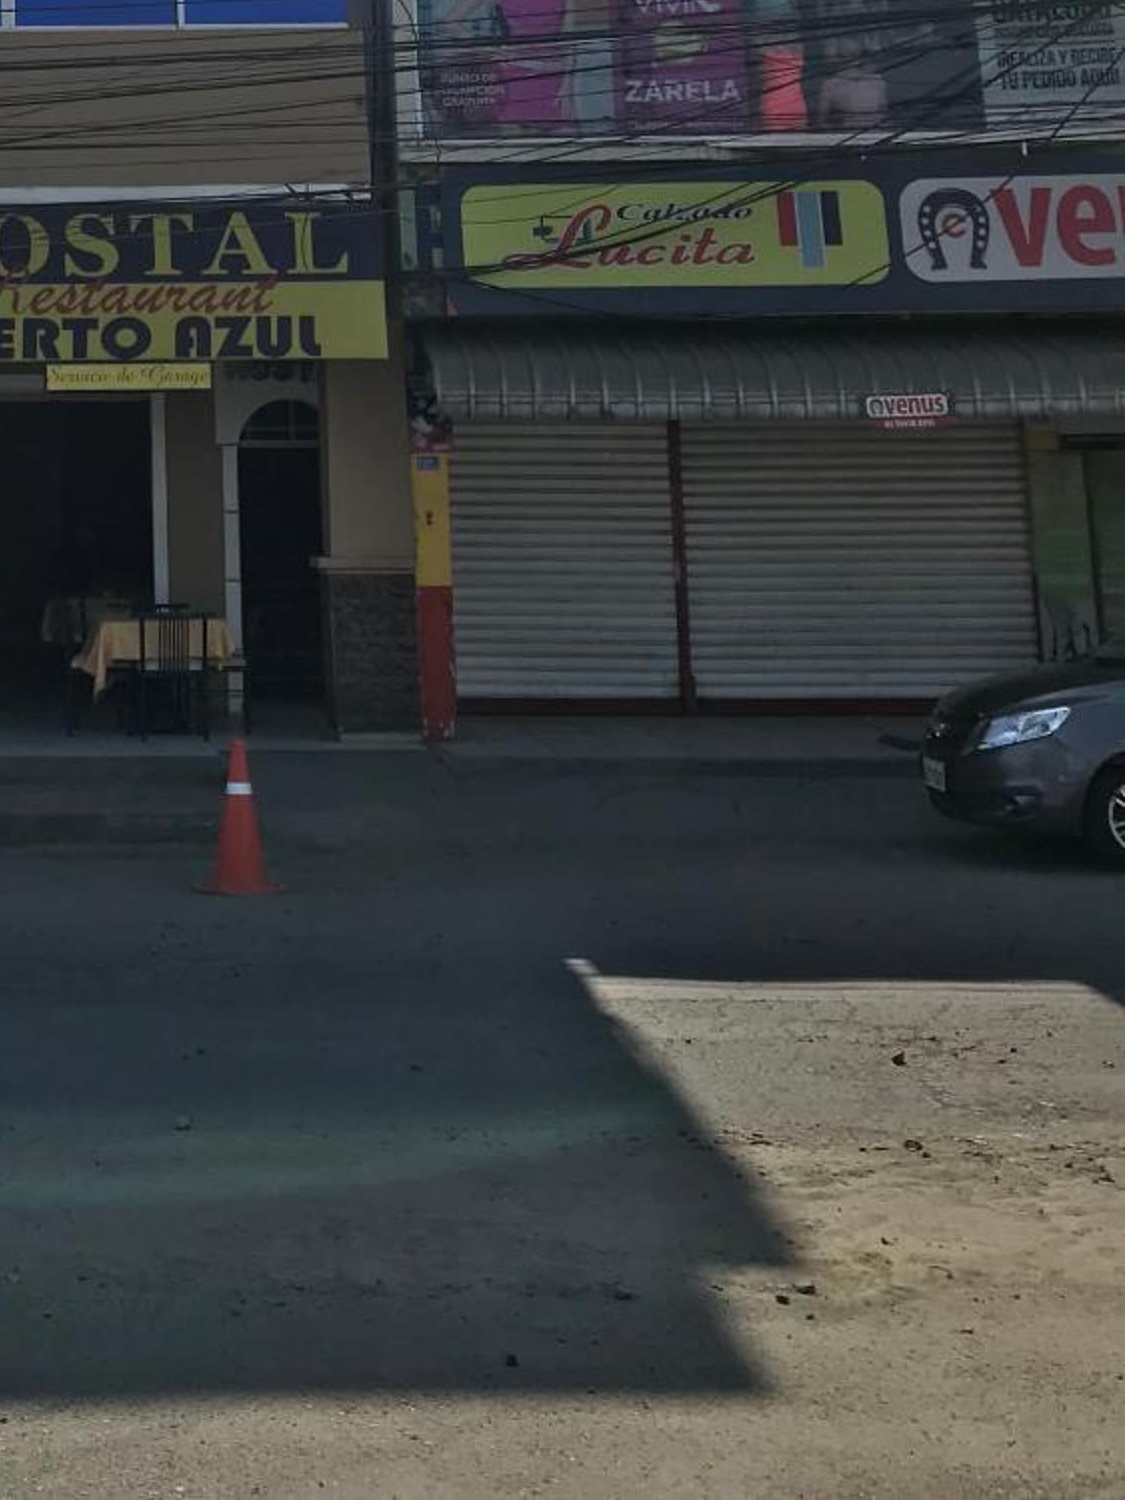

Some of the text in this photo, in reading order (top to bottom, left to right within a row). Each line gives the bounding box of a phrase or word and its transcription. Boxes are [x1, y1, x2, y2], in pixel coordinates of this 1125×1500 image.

[625, 79, 741, 103] ZARELA
[505, 204, 756, 268] Lucita
[989, 184, 1125, 268] ve
[175, 315, 322, 357] AZUL
[883, 396, 944, 415] venus
